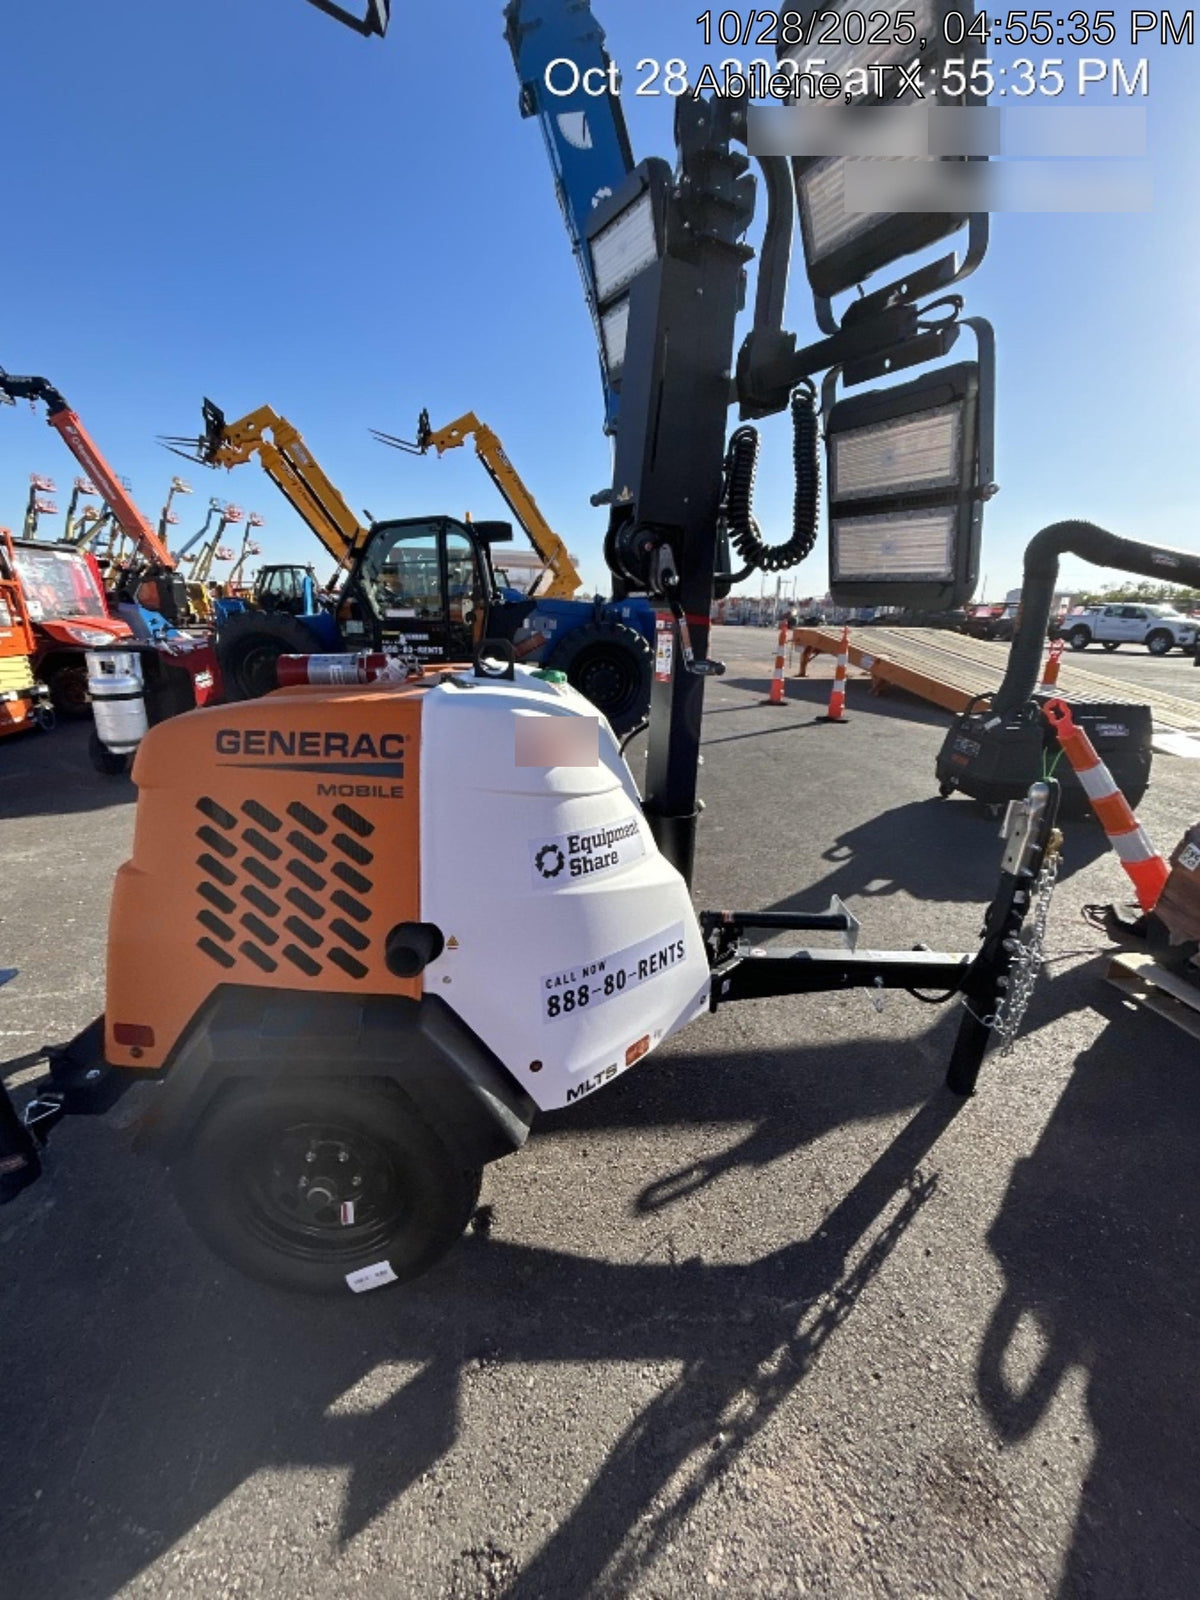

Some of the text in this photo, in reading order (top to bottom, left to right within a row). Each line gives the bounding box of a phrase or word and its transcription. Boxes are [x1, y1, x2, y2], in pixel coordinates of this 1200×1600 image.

[215, 729, 405, 759] GENERAC
[316, 783, 405, 799] MOBILE
[567, 819, 640, 854] Equipment
[569, 851, 620, 877] Share
[545, 960, 607, 990] CALL NOW
[546, 939, 685, 1018] 888-80-RENTS
[566, 1062, 618, 1102] MLTS
